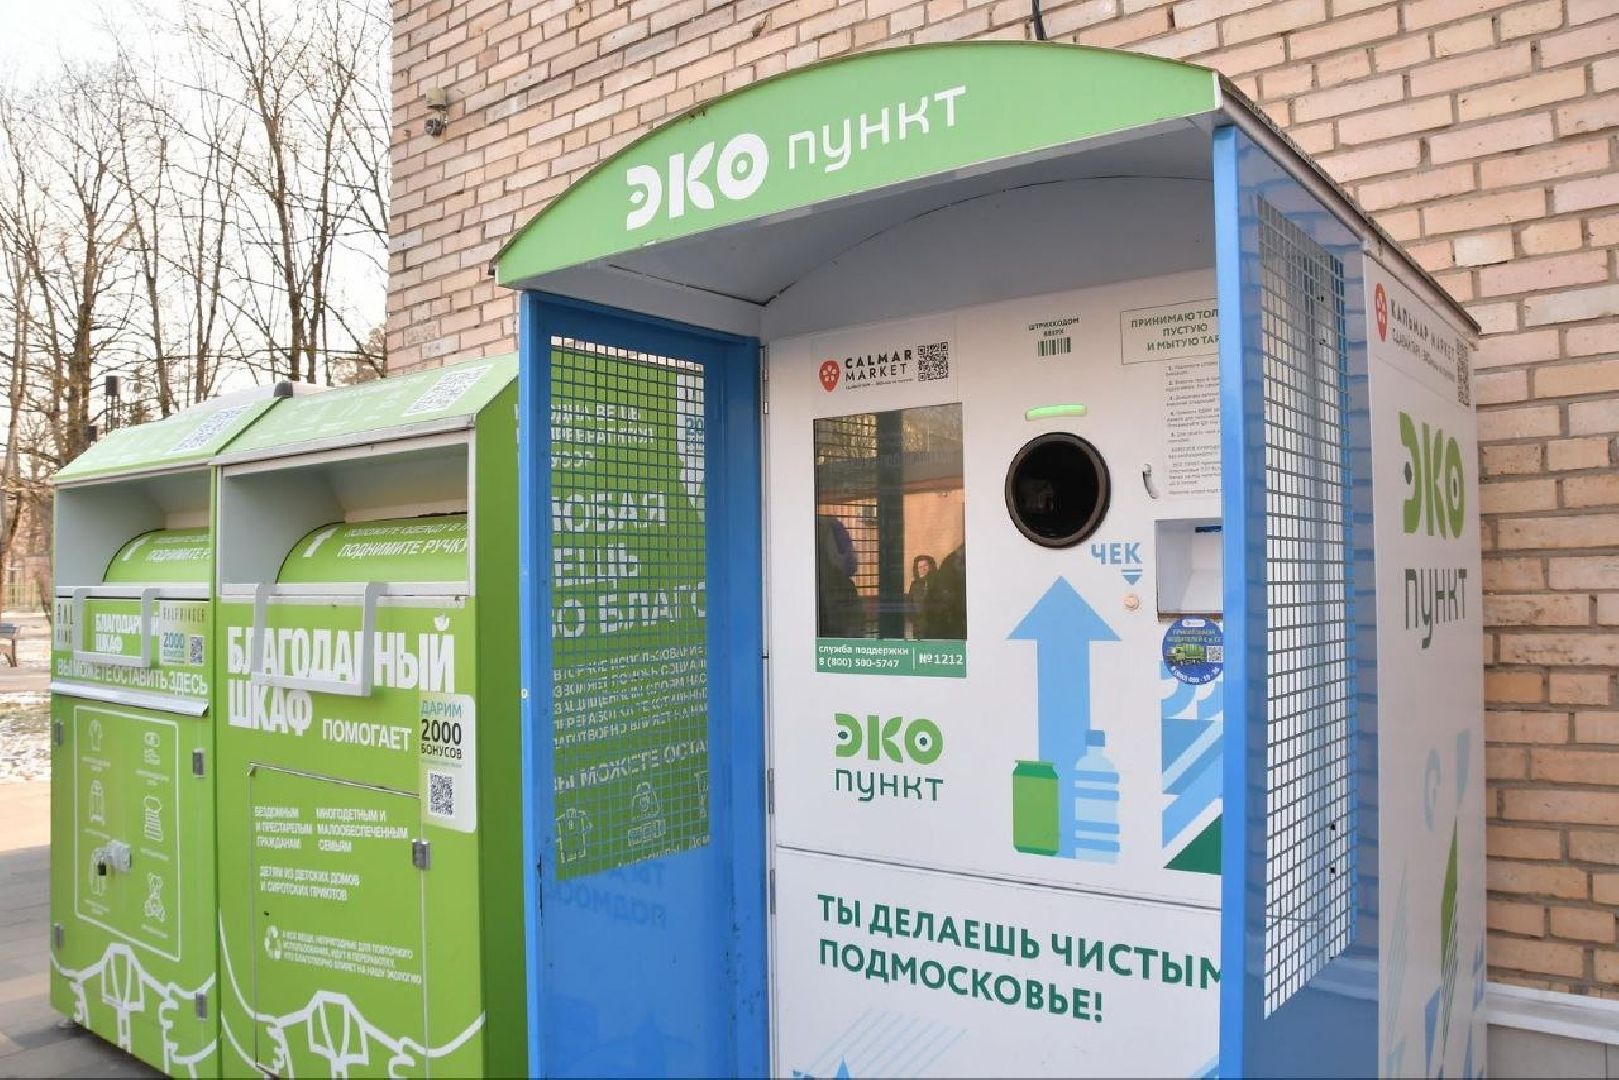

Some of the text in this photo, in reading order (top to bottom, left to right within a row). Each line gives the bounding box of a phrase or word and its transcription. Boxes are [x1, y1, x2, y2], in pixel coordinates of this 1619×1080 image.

[626, 133, 770, 231] ЭКО
[1131, 309, 1219, 328] ПРИНИМАЮ ТОЛ
[1162, 323, 1208, 337] ПУСТУЮ
[1147, 342, 1155, 352] И
[1157, 337, 1199, 351] МЫТУЮ
[846, 350, 912, 369] CALMAR
[846, 364, 907, 382] MARKET
[1398, 411, 1464, 540] ЭКО
[1091, 542, 1143, 565] ЧЕК
[95, 633, 123, 654] ШКАФ
[164, 632, 185, 648] 2000
[818, 644, 909, 656] служба поддержки
[827, 657, 852, 668] (800)
[168, 672, 208, 695] ЗДЕСЬ
[228, 680, 313, 736] ШКАФ
[421, 700, 462, 718] ДАРИМ
[322, 718, 412, 751] ПОМОГАЕТ
[421, 719, 462, 745] 2000
[834, 713, 943, 765] ЭКО
[421, 743, 462, 760] БОНУСОВ
[818, 894, 861, 928] ТЫ
[869, 903, 1040, 959] ДЕЛАЕШЬ
[819, 938, 1103, 1024] ПОДМОСКОВЬЕ!
